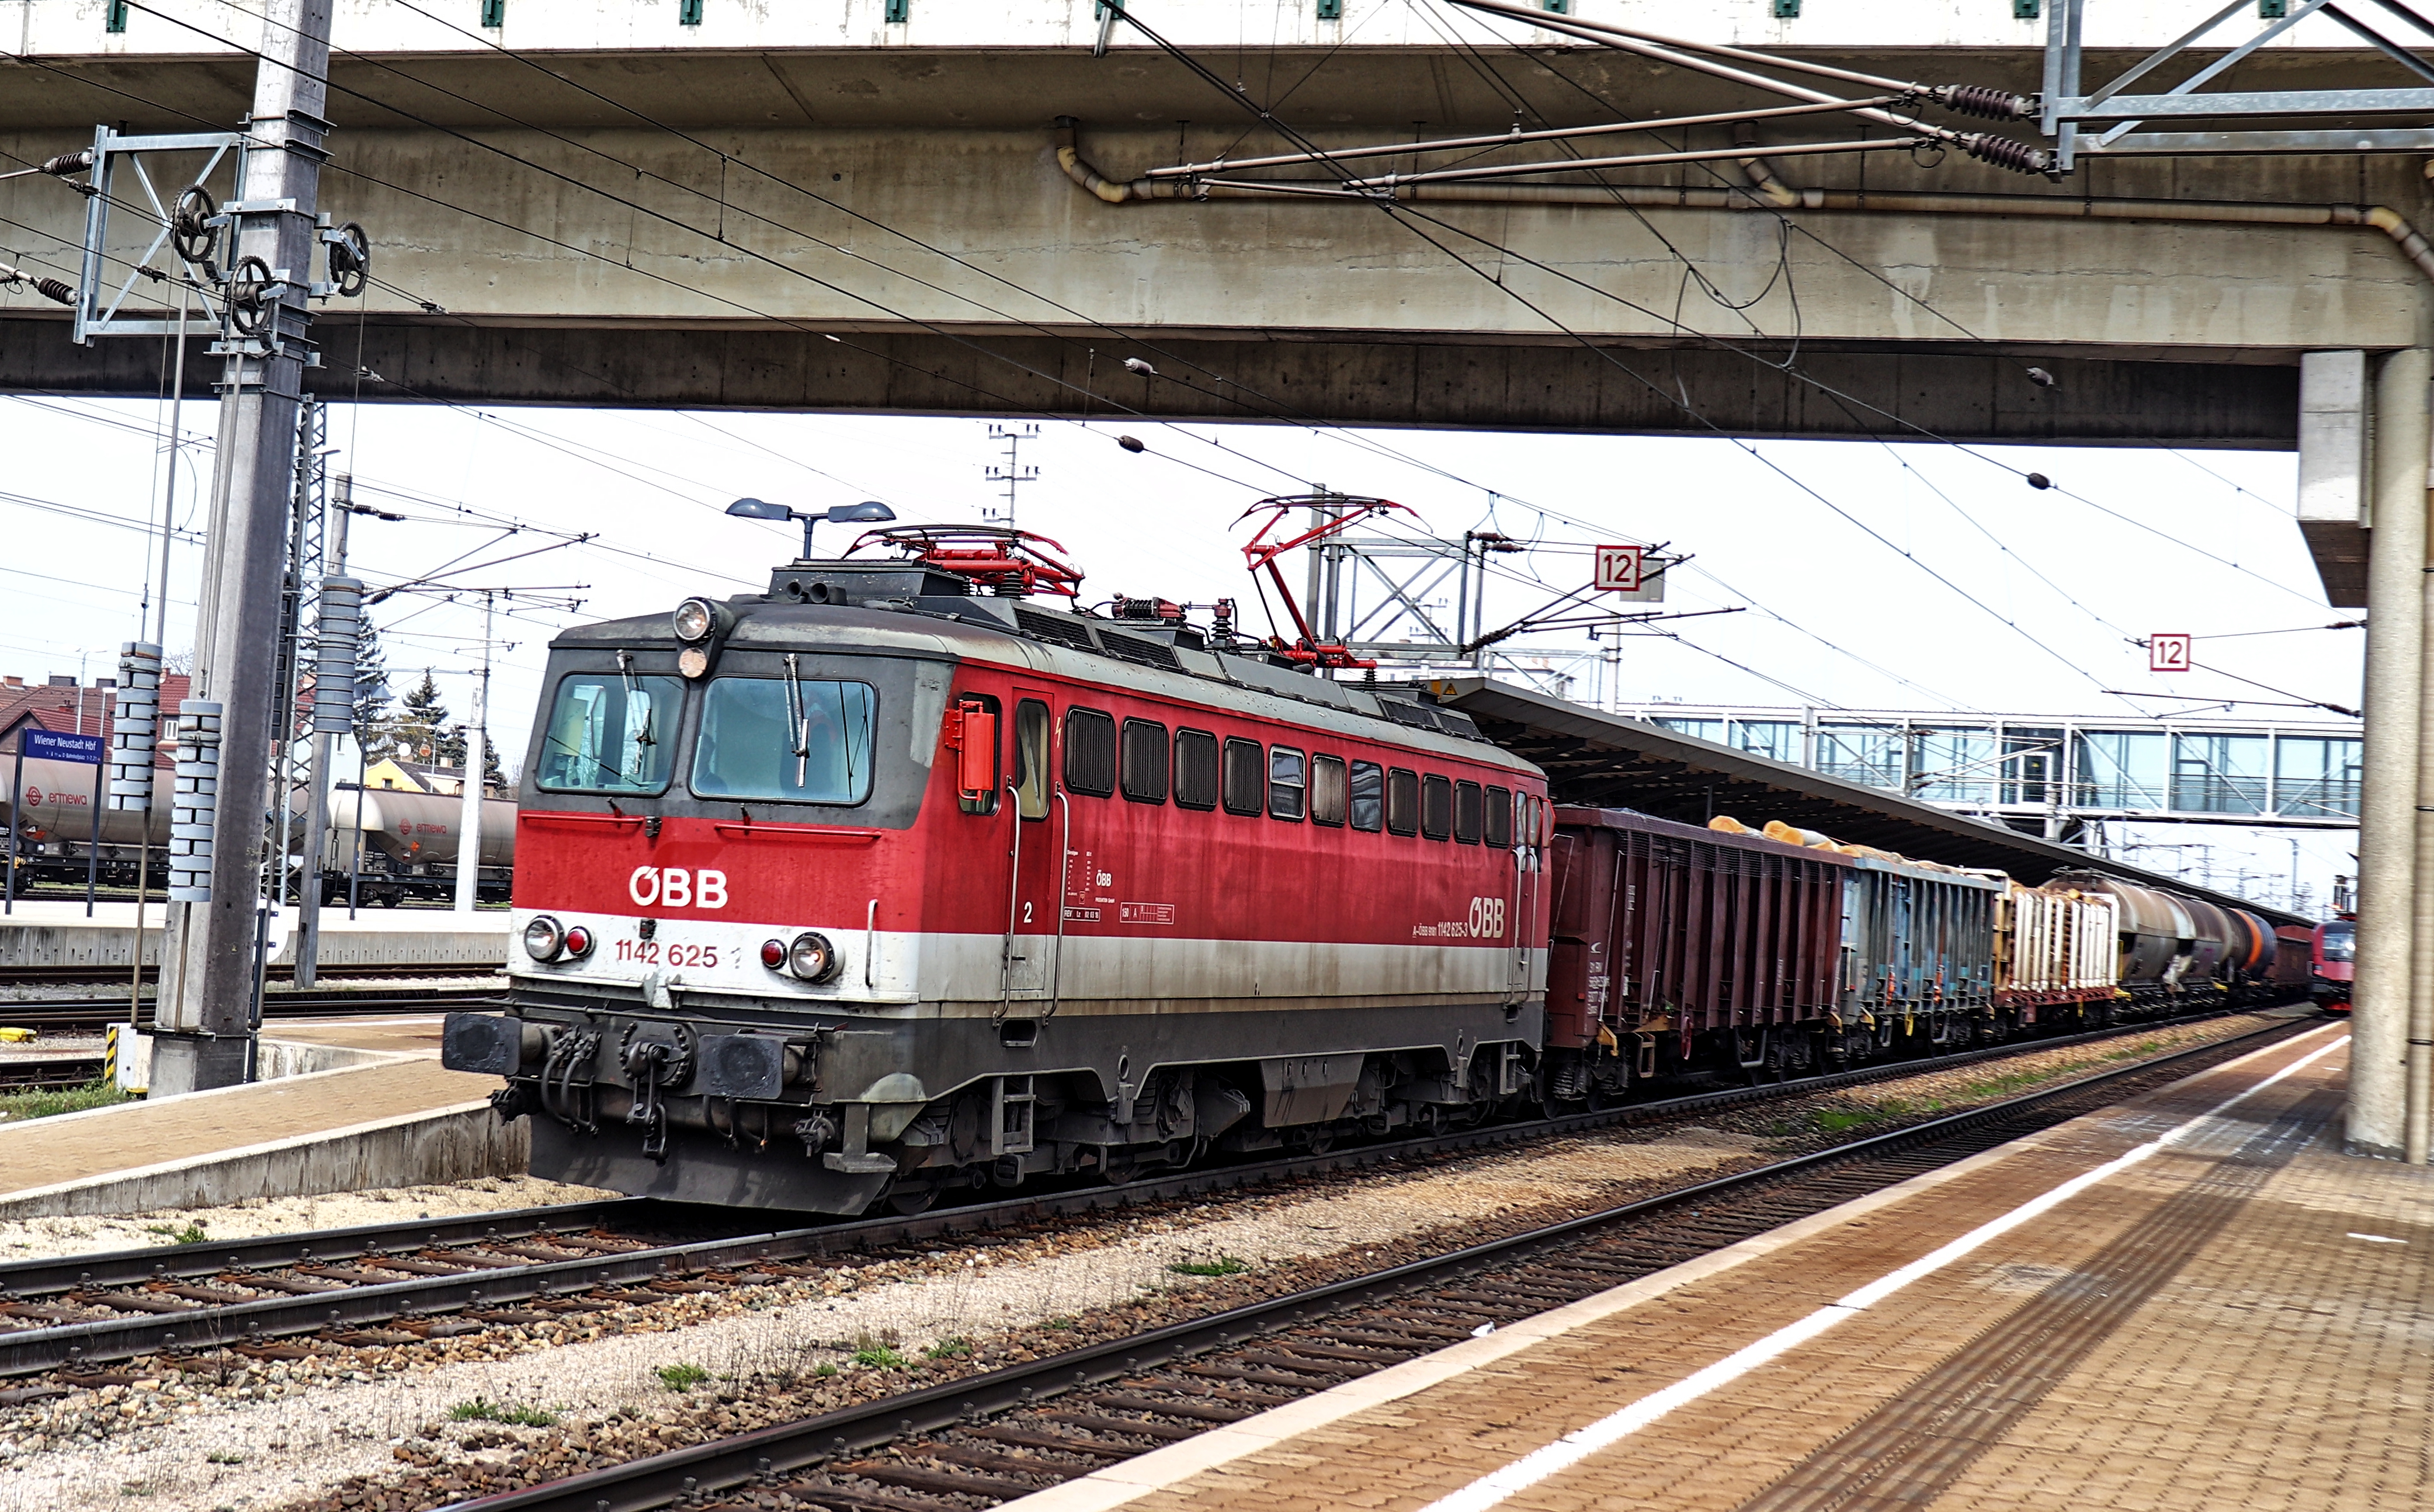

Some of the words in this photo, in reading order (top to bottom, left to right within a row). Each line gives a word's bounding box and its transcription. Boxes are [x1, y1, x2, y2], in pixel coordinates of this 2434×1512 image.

[1604, 554, 1632, 582] 12
[2159, 641, 2182, 664] 12
[34, 734, 57, 746] Wiener
[57, 737, 84, 749] Neustadt
[85, 741, 96, 751] Hbf
[48, 792, 88, 806] ermewa
[416, 822, 447, 835] ermewa
[629, 866, 728, 909] ÖBB
[1096, 869, 1112, 887] ÖBB
[1023, 901, 1033, 923] 2
[1468, 896, 1505, 938] ÖBB
[1438, 921, 1451, 937] 1142
[1452, 922, 1468, 937] 625-3
[616, 939, 659, 964] 1142
[668, 944, 718, 968] 625
